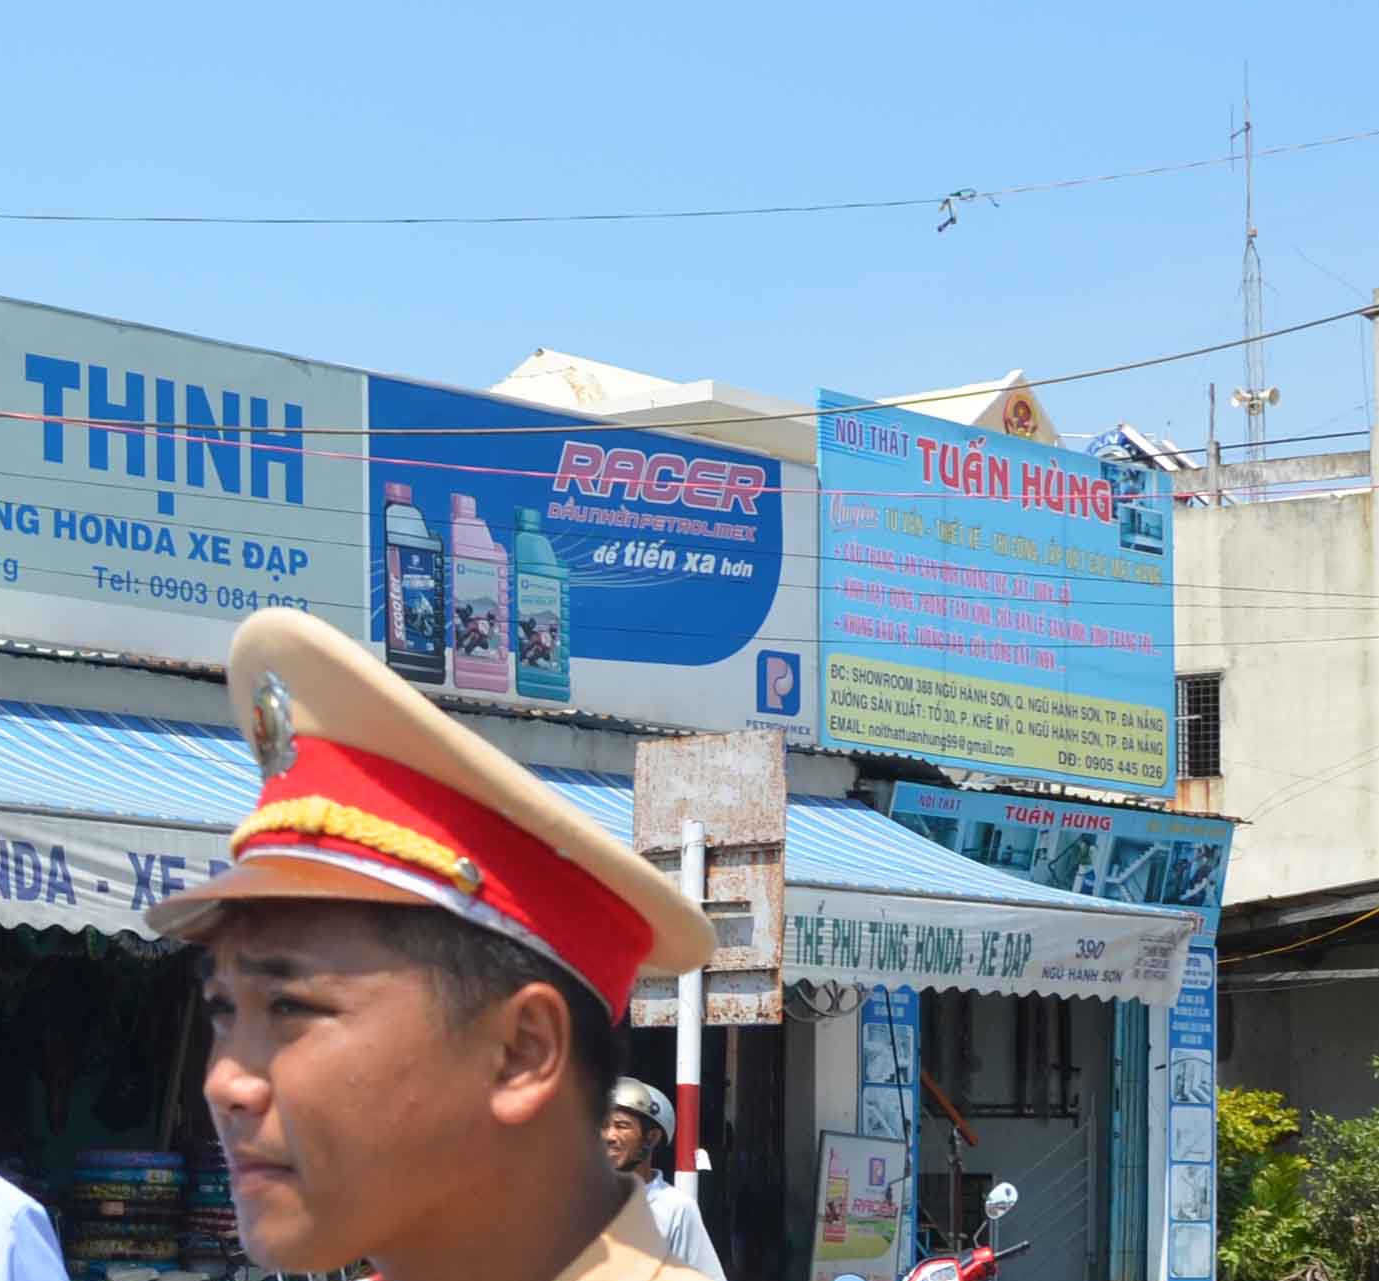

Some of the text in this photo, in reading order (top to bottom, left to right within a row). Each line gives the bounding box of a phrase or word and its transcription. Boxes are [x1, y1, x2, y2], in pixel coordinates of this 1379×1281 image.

[25, 353, 303, 516] THỊNH
[552, 440, 766, 515] RACER
[835, 415, 863, 452] NỘI
[870, 422, 910, 458] THẤT
[1021, 457, 1114, 525] HÙNG
[53, 509, 176, 556] HONDA
[187, 533, 230, 565] XE
[243, 540, 308, 582] ĐẠP
[593, 539, 754, 578] để tiến xa hơn
[92, 565, 139, 595] Tel:
[150, 575, 208, 605] 0903
[217, 586, 259, 611] 084
[852, 667, 913, 690] SHOWROOM
[830, 715, 865, 735] EMAIL:
[1085, 755, 1114, 772] 0905
[1117, 760, 1139, 776] 445
[1141, 763, 1163, 780] 026
[1061, 810, 1113, 831] HÙNG
[915, 925, 963, 974] HONDA
[977, 929, 1000, 977] XE
[1076, 938, 1105, 961] 390
